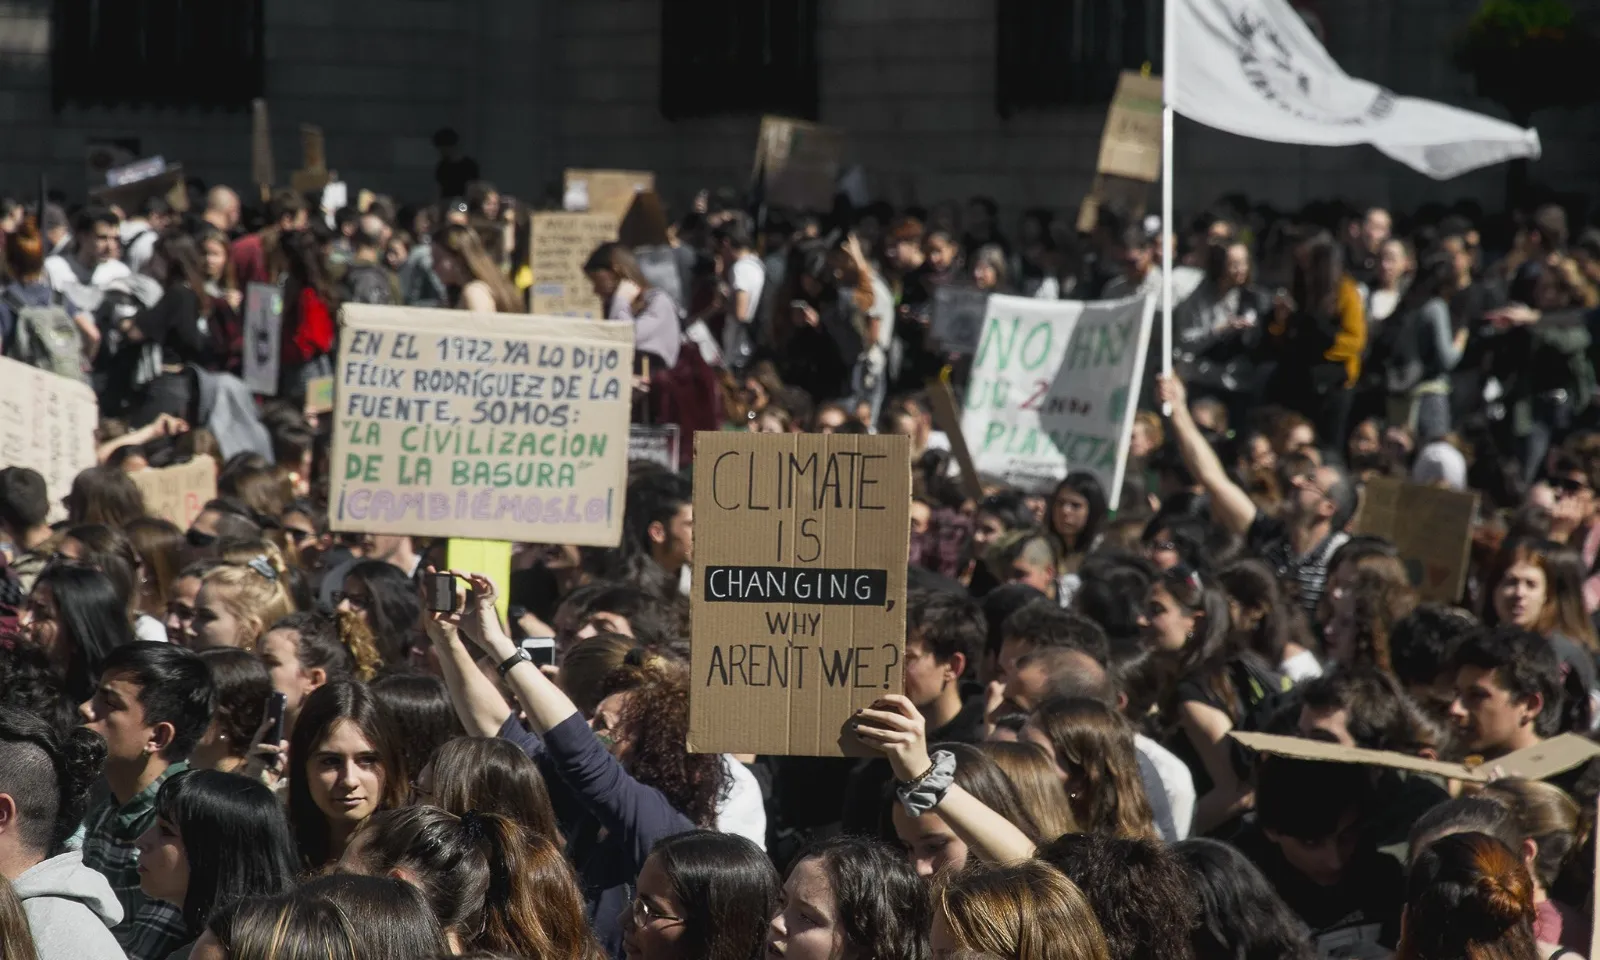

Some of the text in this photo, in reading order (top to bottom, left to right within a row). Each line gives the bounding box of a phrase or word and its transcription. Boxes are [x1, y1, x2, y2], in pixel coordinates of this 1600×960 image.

[350, 329, 383, 356] EN
[391, 333, 419, 360] EL
[503, 339, 530, 364] YA
[537, 345, 564, 368] LO
[974, 316, 1054, 372] NO
[345, 359, 619, 399] FÉLIX RODRÍGUEZ DE LA
[348, 393, 580, 427] FUENTE, SOMOS:
[345, 453, 383, 482] DE
[397, 454, 433, 486] LA
[712, 450, 888, 511] CLIMATE
[777, 518, 822, 562] IS
[765, 611, 821, 637] WHY
[706, 639, 899, 690] AREN'T WE?
